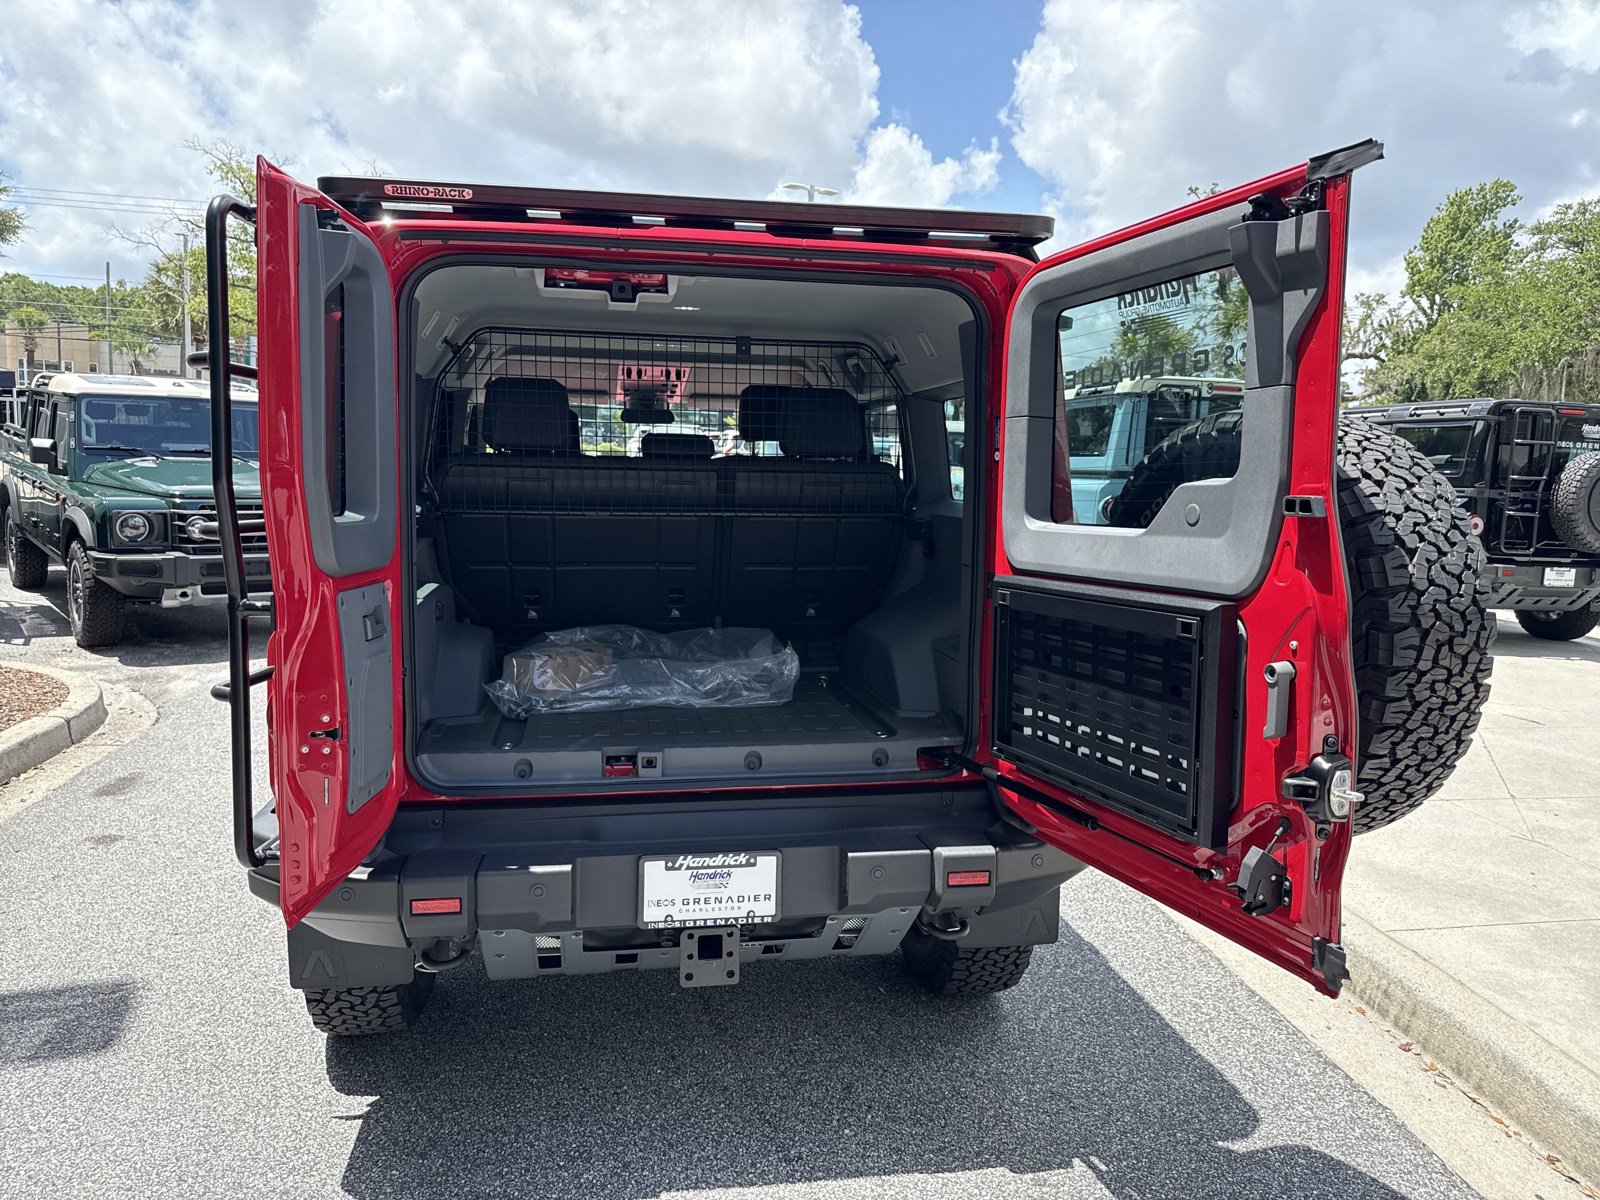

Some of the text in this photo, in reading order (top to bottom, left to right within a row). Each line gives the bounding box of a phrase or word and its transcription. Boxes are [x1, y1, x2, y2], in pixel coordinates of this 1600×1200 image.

[391, 185, 466, 199] RHINO-RACK
[674, 853, 749, 870] Hendrick
[688, 869, 733, 884] Hendrick
[647, 893, 772, 908] INEOS GRENADIER
[678, 905, 742, 914] CHARLESTON
[648, 916, 773, 929] INEOS GRENADIER
